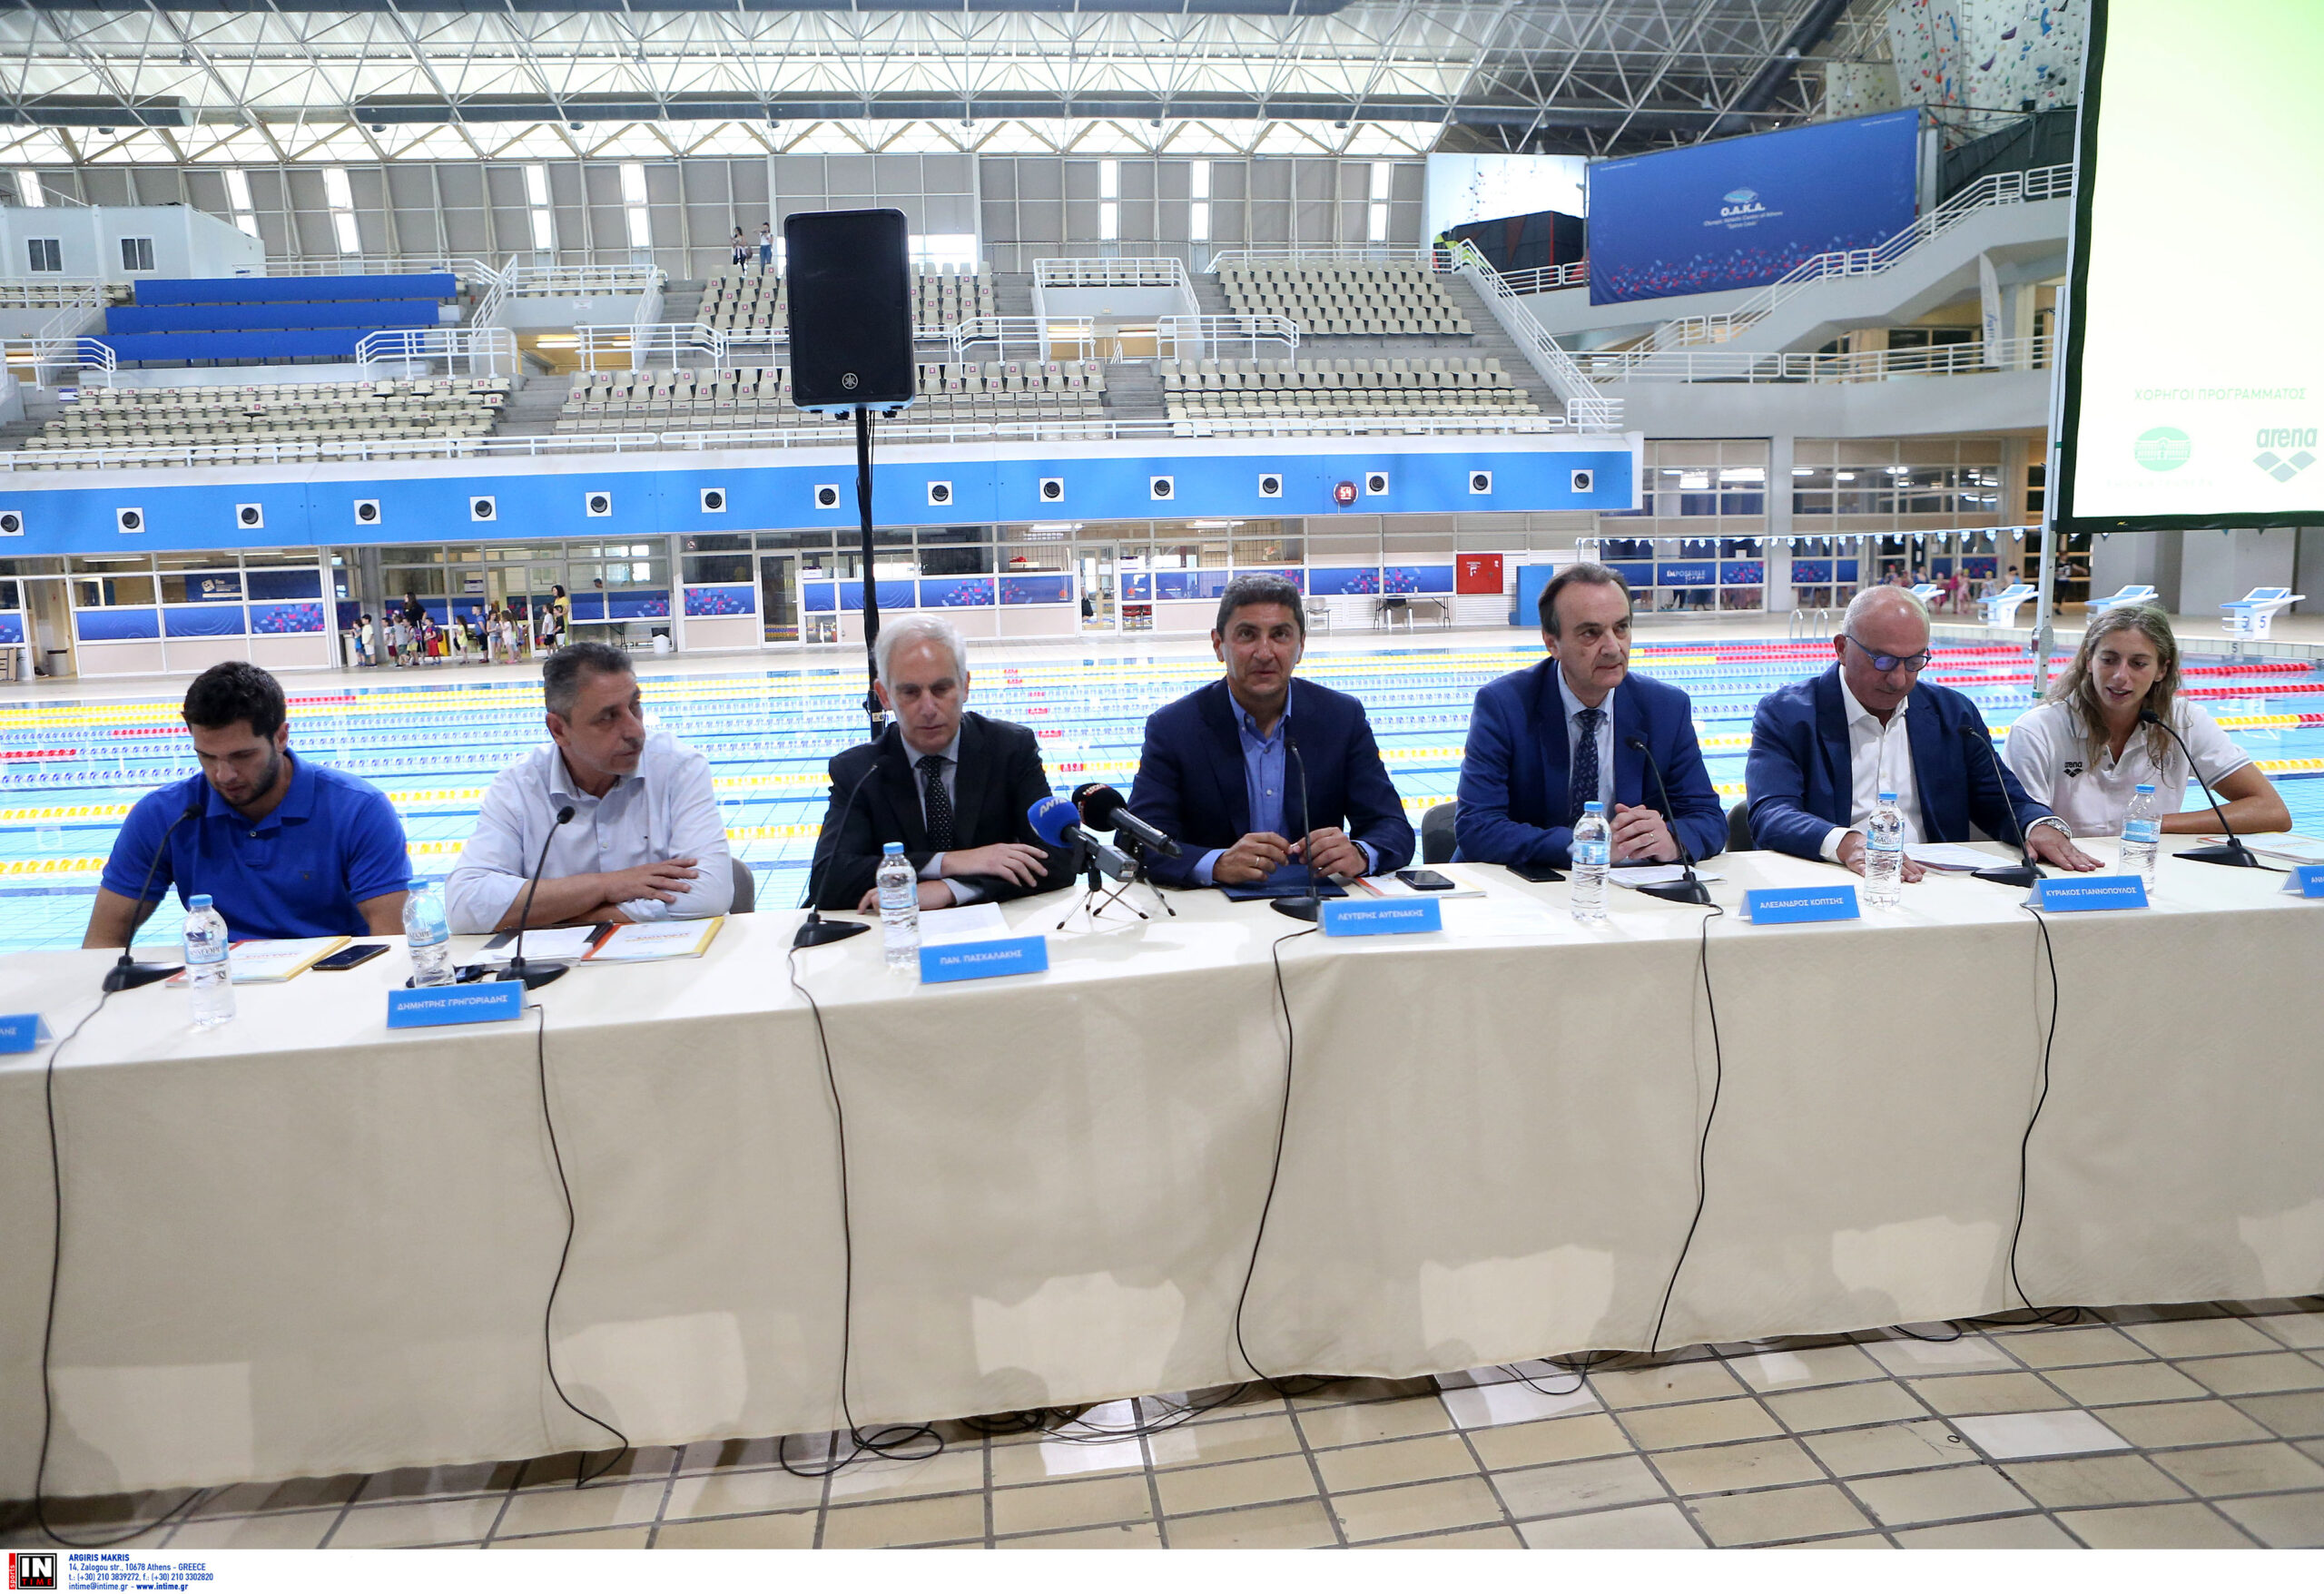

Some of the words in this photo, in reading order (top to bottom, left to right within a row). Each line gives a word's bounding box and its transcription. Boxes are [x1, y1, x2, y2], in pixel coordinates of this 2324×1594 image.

[2134, 389, 2194, 401] ΧΟΡΗΓΟΙ
[2198, 388, 2307, 400] ΠΡΟΓΡΑΜΜΑΤΟΣ
[2256, 428, 2318, 448] arena
[2260, 615, 2267, 629] 5
[2082, 887, 2137, 895] ΓΙΑΝΝΟΠΟΥΛΟΣ
[1759, 900, 1809, 909] ΑΛΕΞΑΝΔΡΟΣ
[1810, 897, 1844, 906] ΚΟΠΤΣΗΣ
[1337, 911, 1377, 920] ΛΕΥΤΕΡΗΣ
[1378, 910, 1423, 919] ΑΥΓΕΝΑΚΗΣ
[963, 950, 1023, 962] ΠΑΣΧΑΛΑΚΗΣ
[397, 999, 446, 1010] ΔΗΜΗΤΡΗΣ
[448, 995, 508, 1007] ΓΡΗΓΟΡΙΑΔΗΣ
